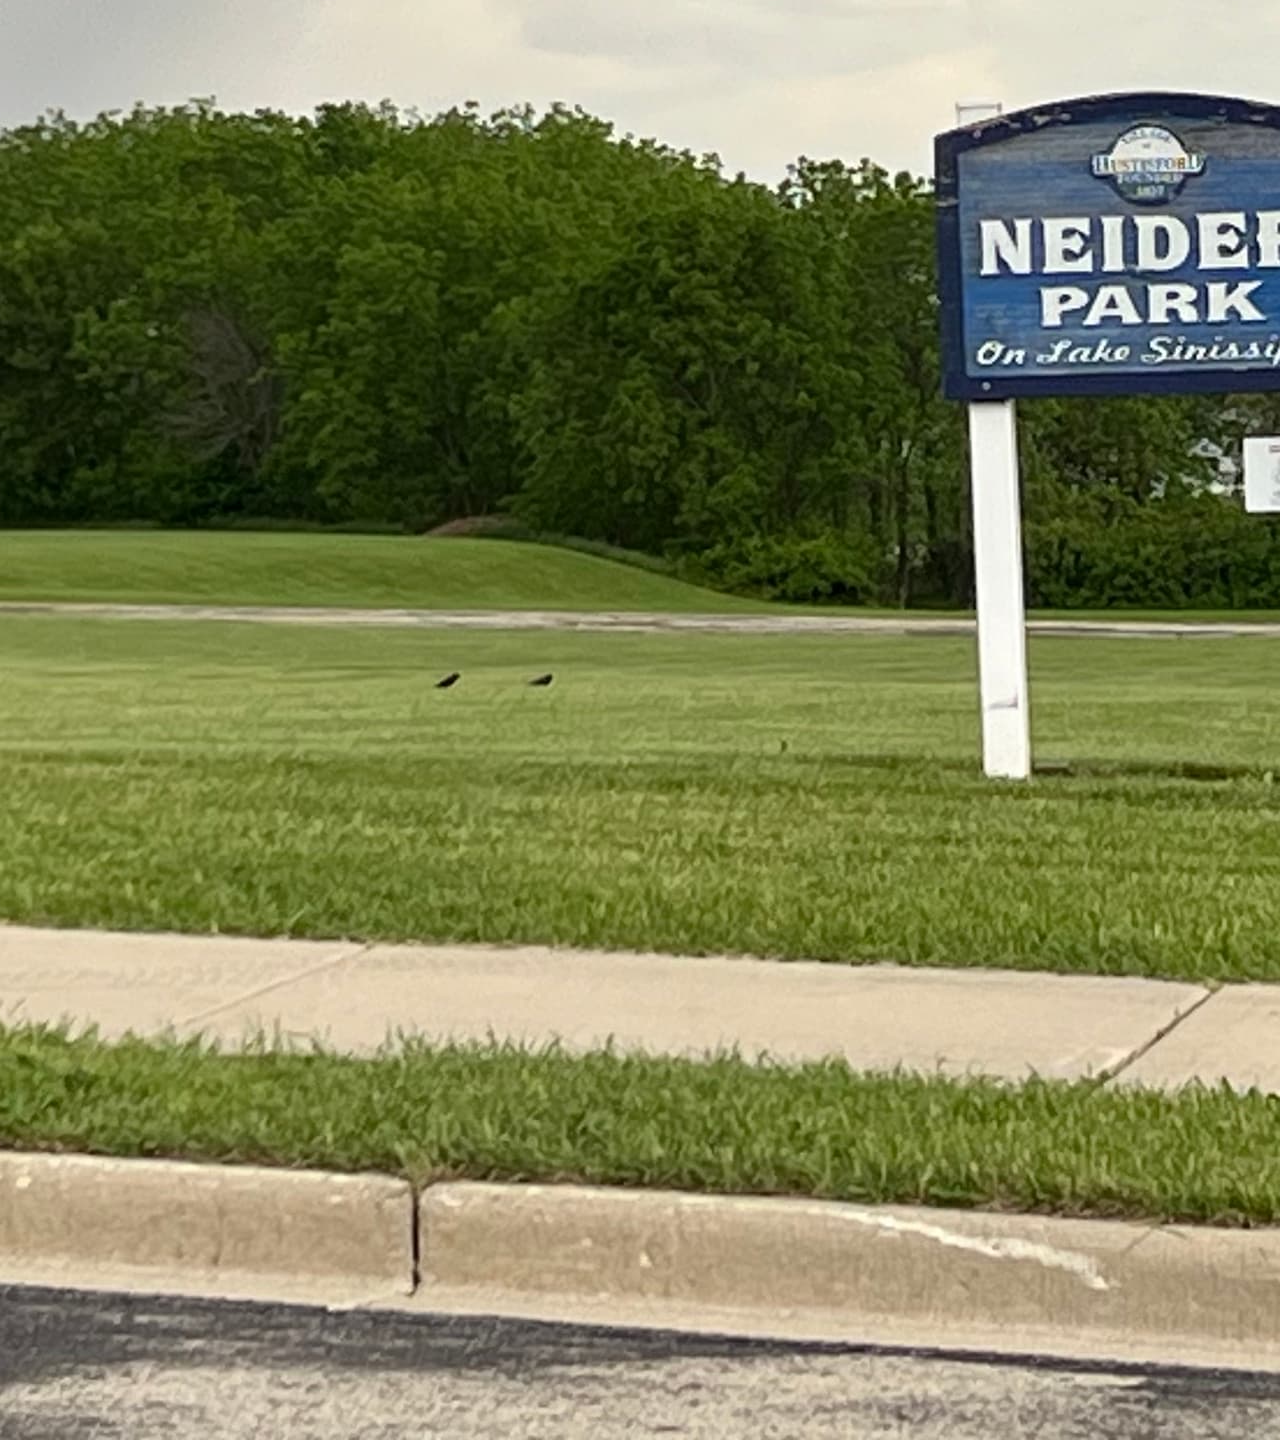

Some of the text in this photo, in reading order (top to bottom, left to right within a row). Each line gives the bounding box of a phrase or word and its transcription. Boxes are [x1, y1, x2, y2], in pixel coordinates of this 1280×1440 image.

[1040, 280, 1267, 327] PARK
[976, 341, 1026, 366] On
[1036, 339, 1131, 364] Lake
